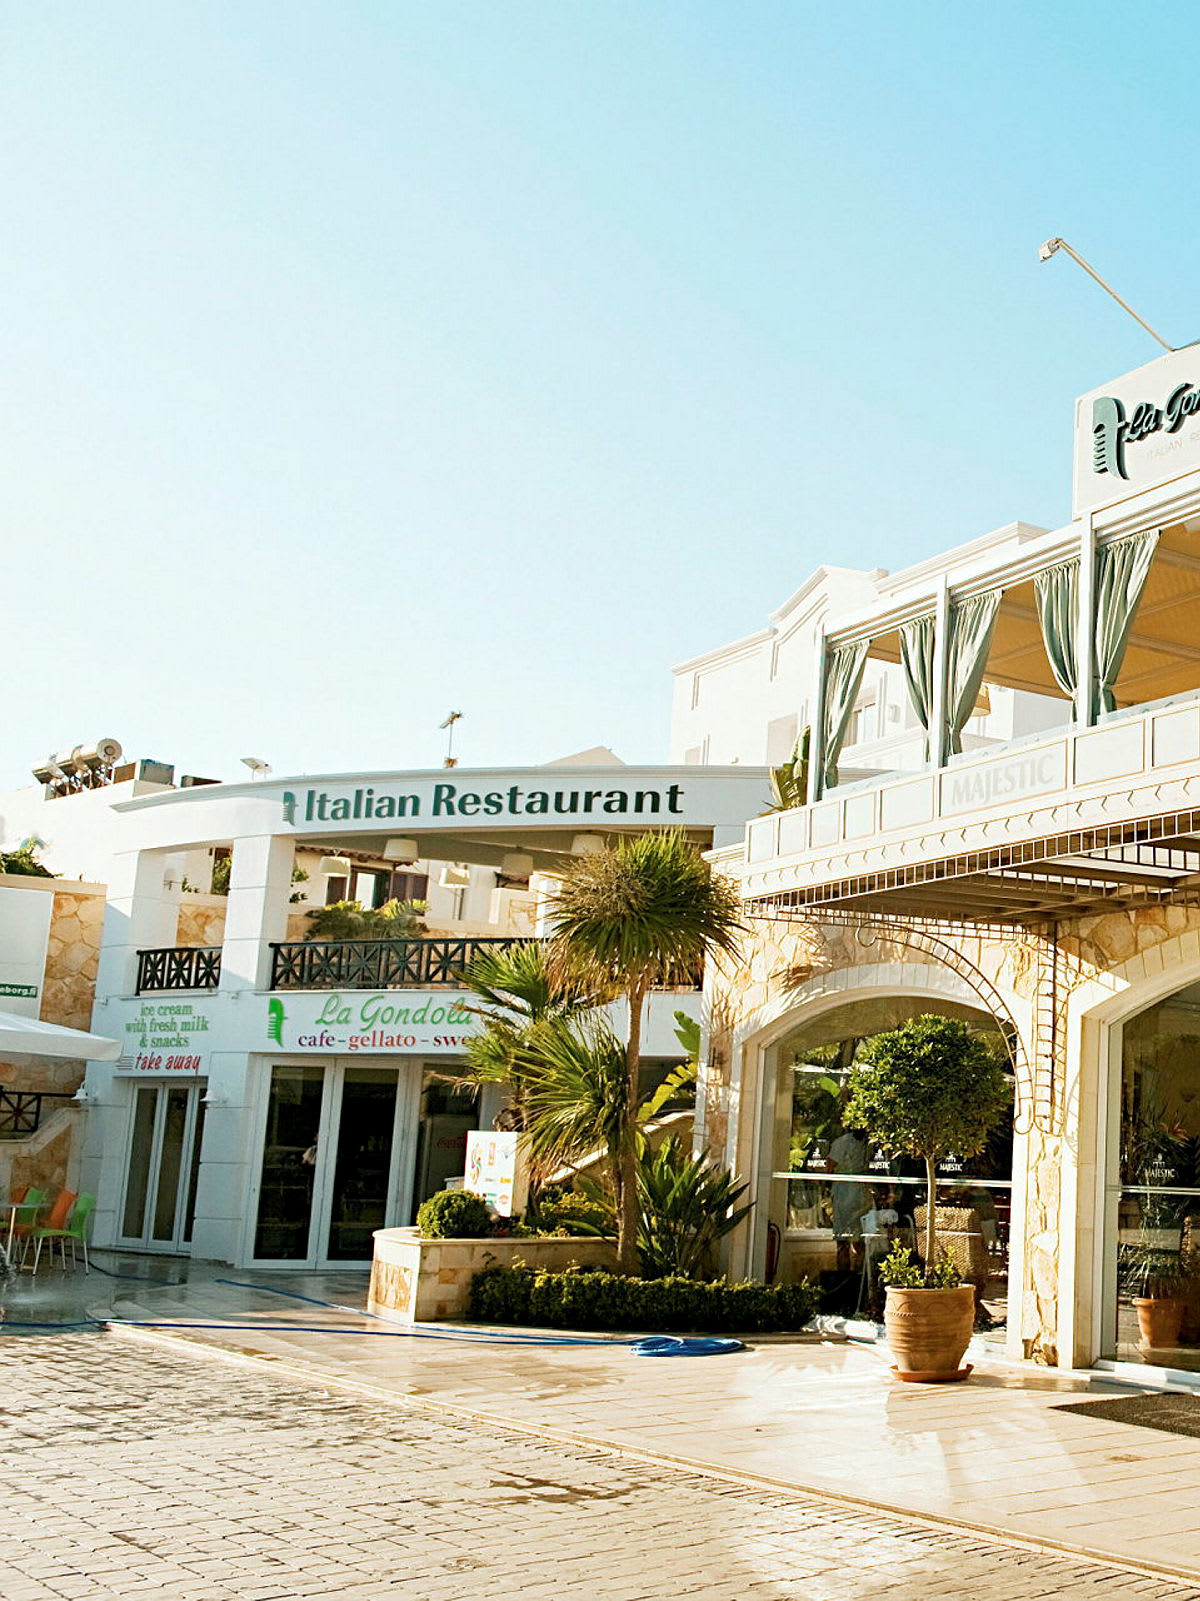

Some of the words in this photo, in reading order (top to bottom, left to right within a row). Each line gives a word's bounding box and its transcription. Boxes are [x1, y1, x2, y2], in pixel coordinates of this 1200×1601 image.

[1122, 402, 1164, 443] La
[951, 754, 1055, 806] MAJESTIC
[304, 787, 420, 821] Italian
[431, 783, 684, 816] Restaurant
[125, 1018, 147, 1032] with
[149, 1017, 178, 1032] fresh
[180, 1016, 210, 1031] milk
[140, 1002, 155, 1016] ice
[157, 1004, 193, 1016] cream
[314, 994, 354, 1026] La
[359, 994, 474, 1032] Gondola
[139, 1034, 148, 1047] &
[150, 1033, 190, 1047] snacks
[135, 1052, 163, 1070] take
[165, 1055, 202, 1076] away
